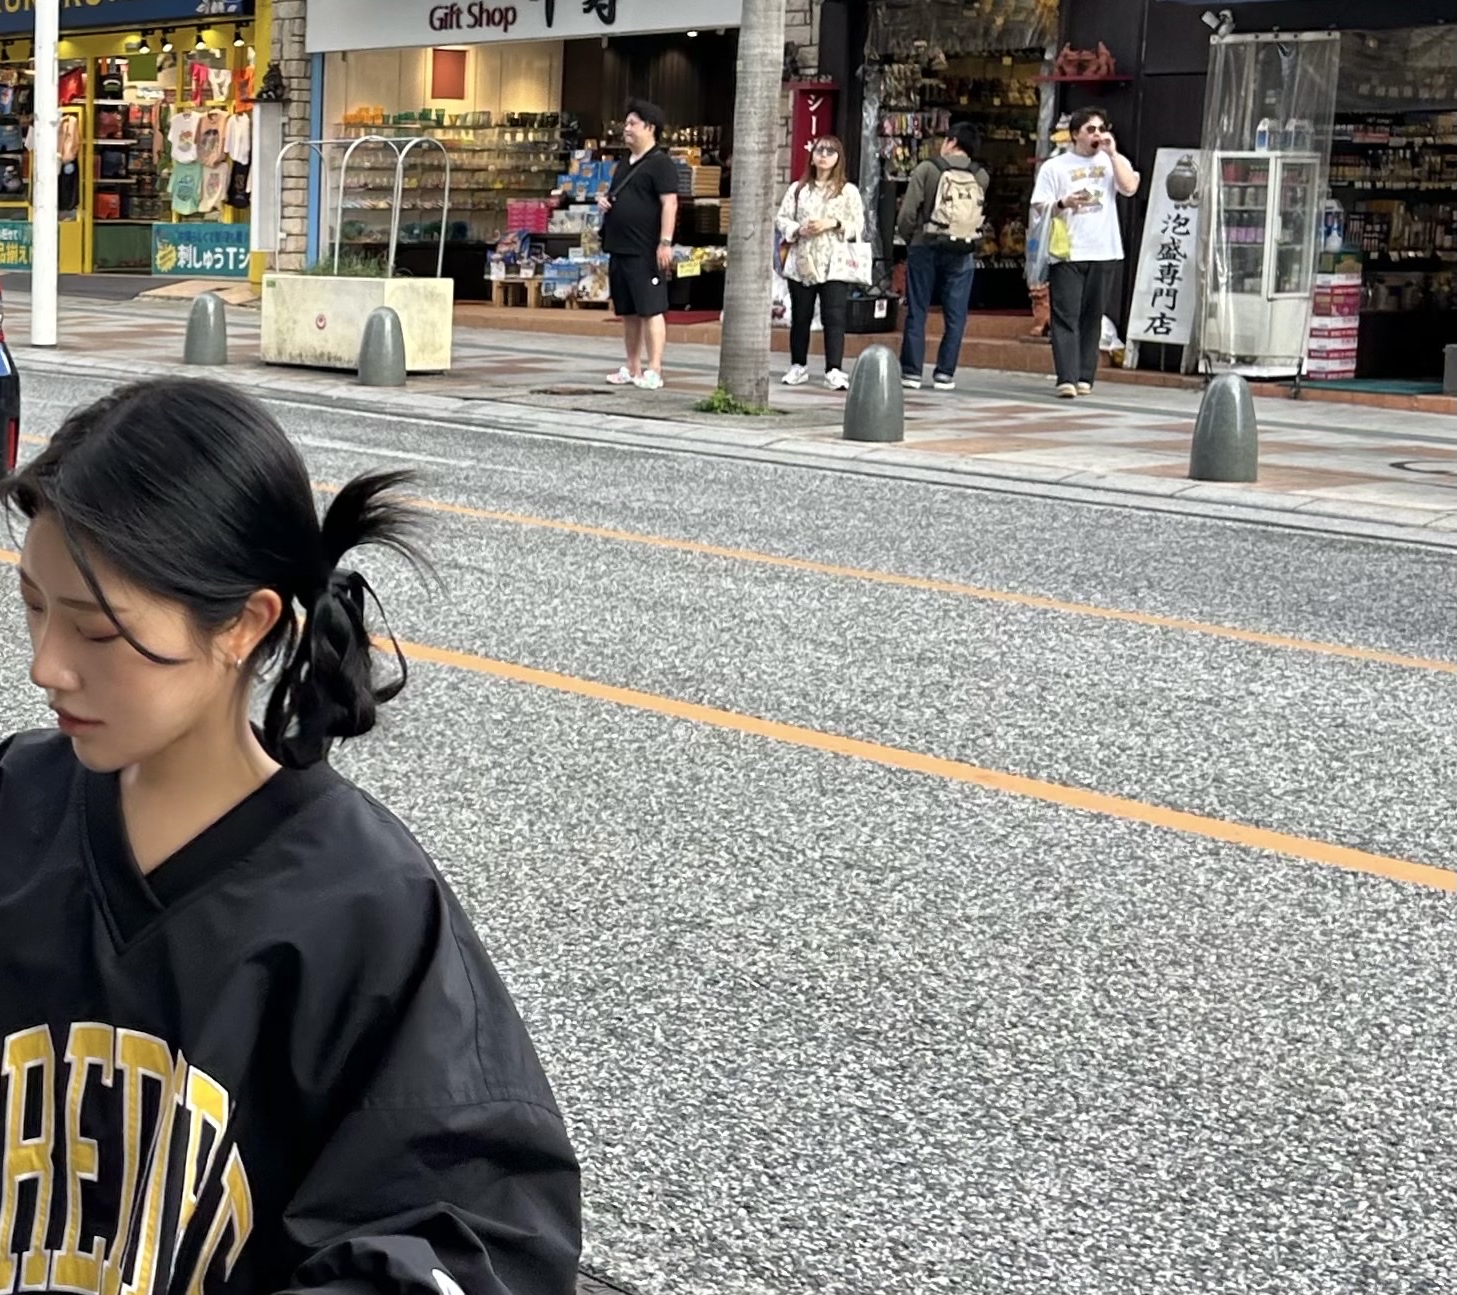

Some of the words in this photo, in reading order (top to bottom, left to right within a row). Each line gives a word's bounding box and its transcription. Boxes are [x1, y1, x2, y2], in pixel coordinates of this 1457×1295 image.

[429, 3, 462, 31] Gift
[466, 1, 517, 32] Shop
[1144, 213, 1191, 336] 泡盛専門店
